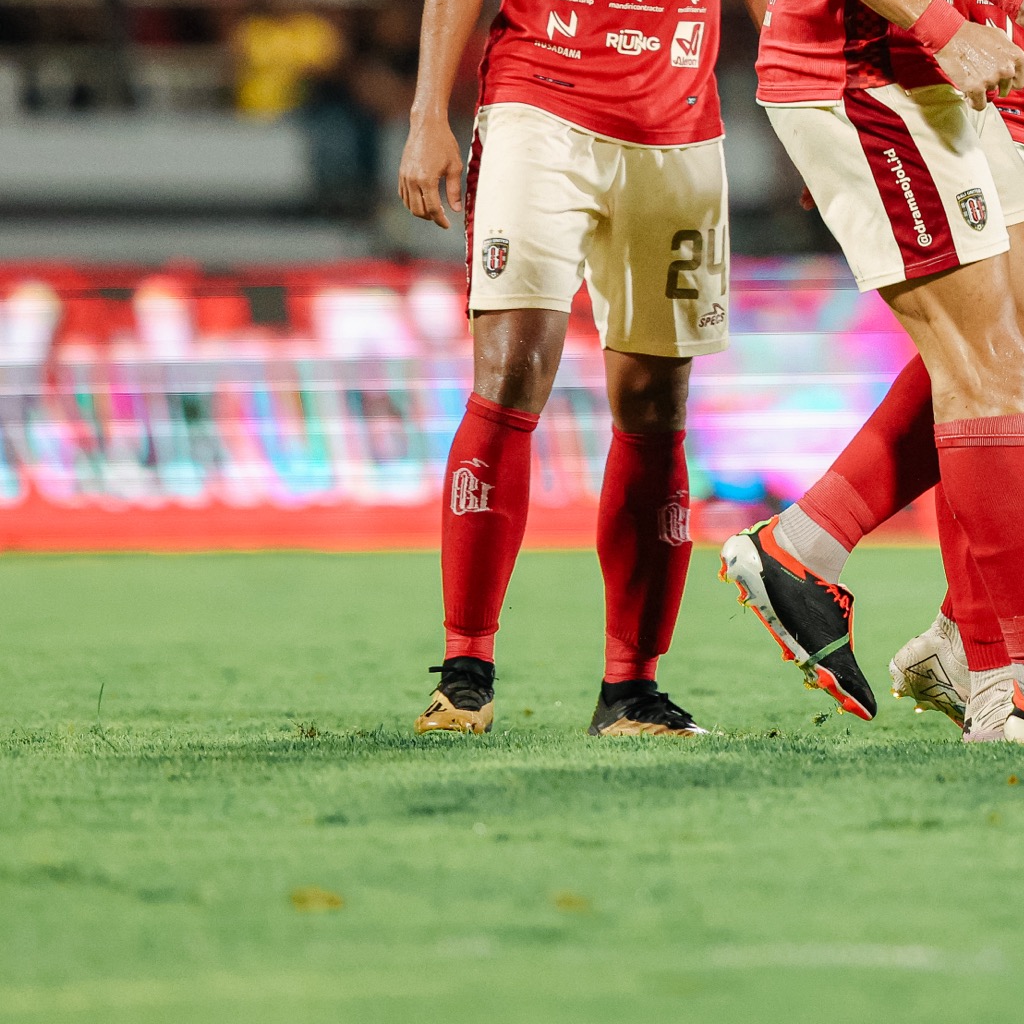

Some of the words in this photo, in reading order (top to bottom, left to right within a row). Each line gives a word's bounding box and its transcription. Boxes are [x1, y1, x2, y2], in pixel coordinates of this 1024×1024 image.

[608, 2, 665, 13] mandiricontractor
[665, 224, 729, 300] 24
[698, 312, 725, 327] SPECS
